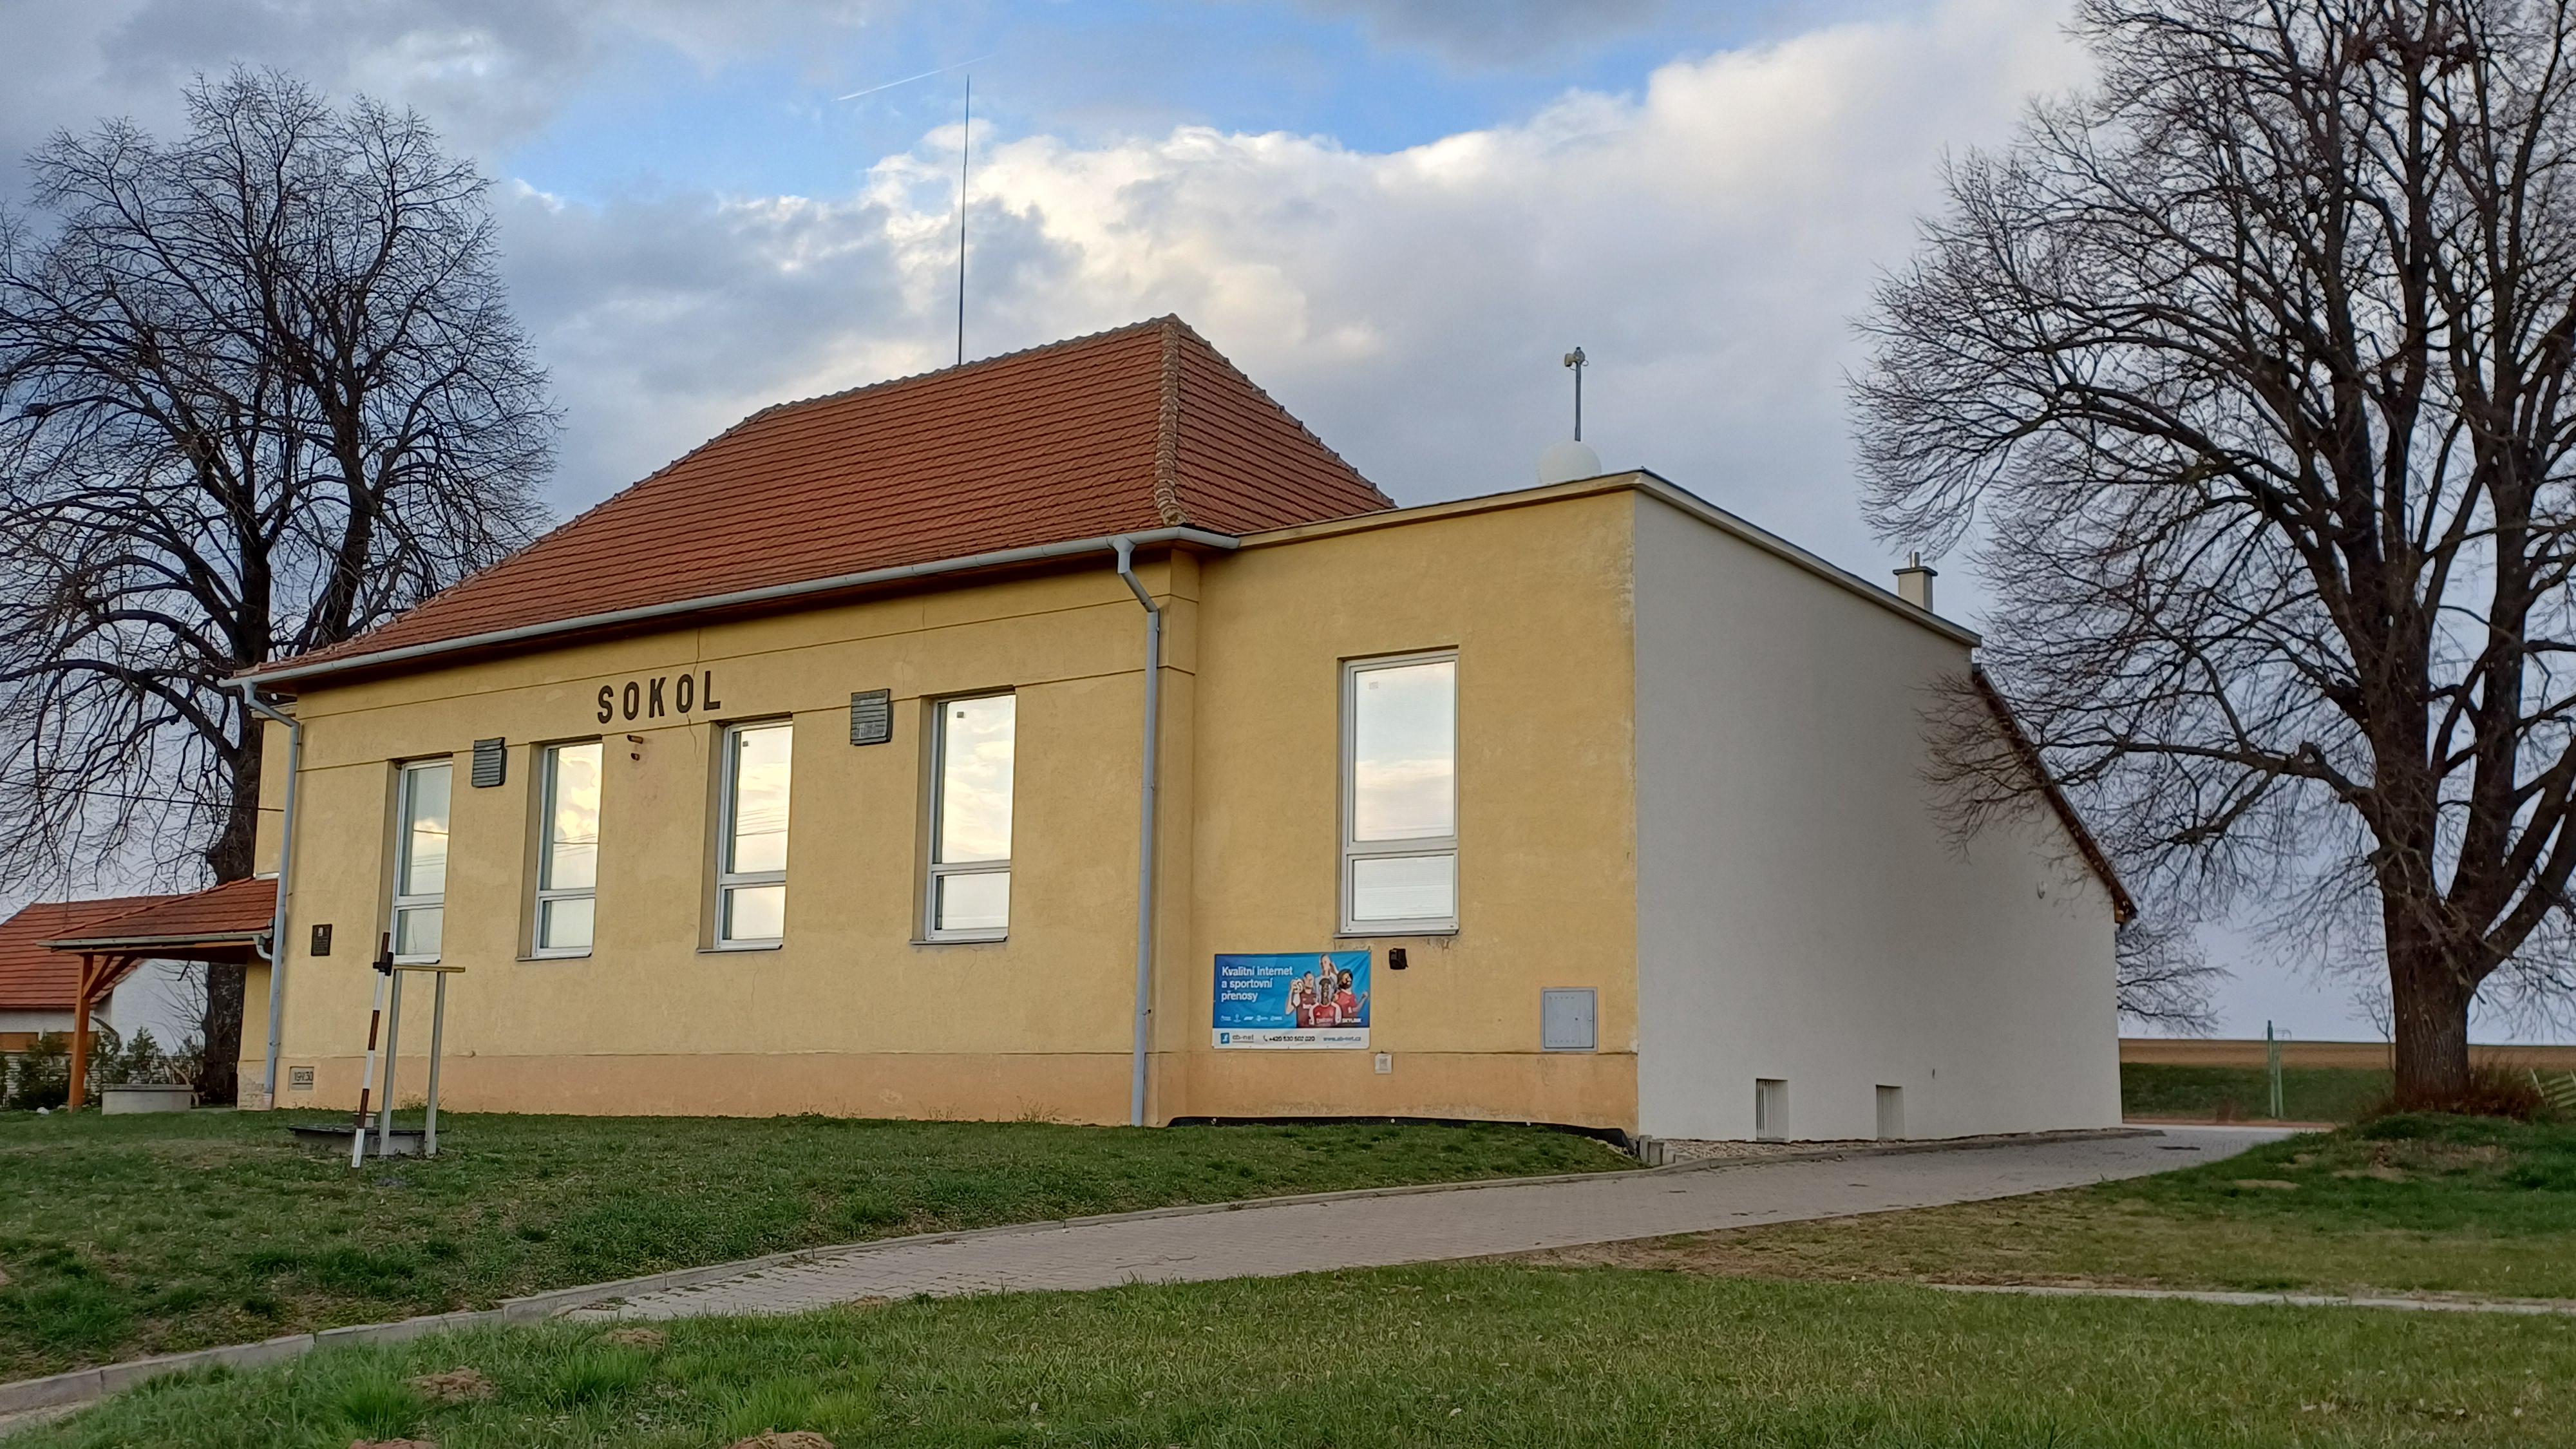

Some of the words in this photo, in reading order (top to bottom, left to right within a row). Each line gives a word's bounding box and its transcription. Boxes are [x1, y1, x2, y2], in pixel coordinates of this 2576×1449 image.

[598, 670, 721, 724] SOKOL
[1222, 966, 1255, 976] Kvalitní
[1257, 966, 1293, 976] internet
[1229, 978, 1273, 990] sportovní
[1221, 991, 1258, 1003] přenosy
